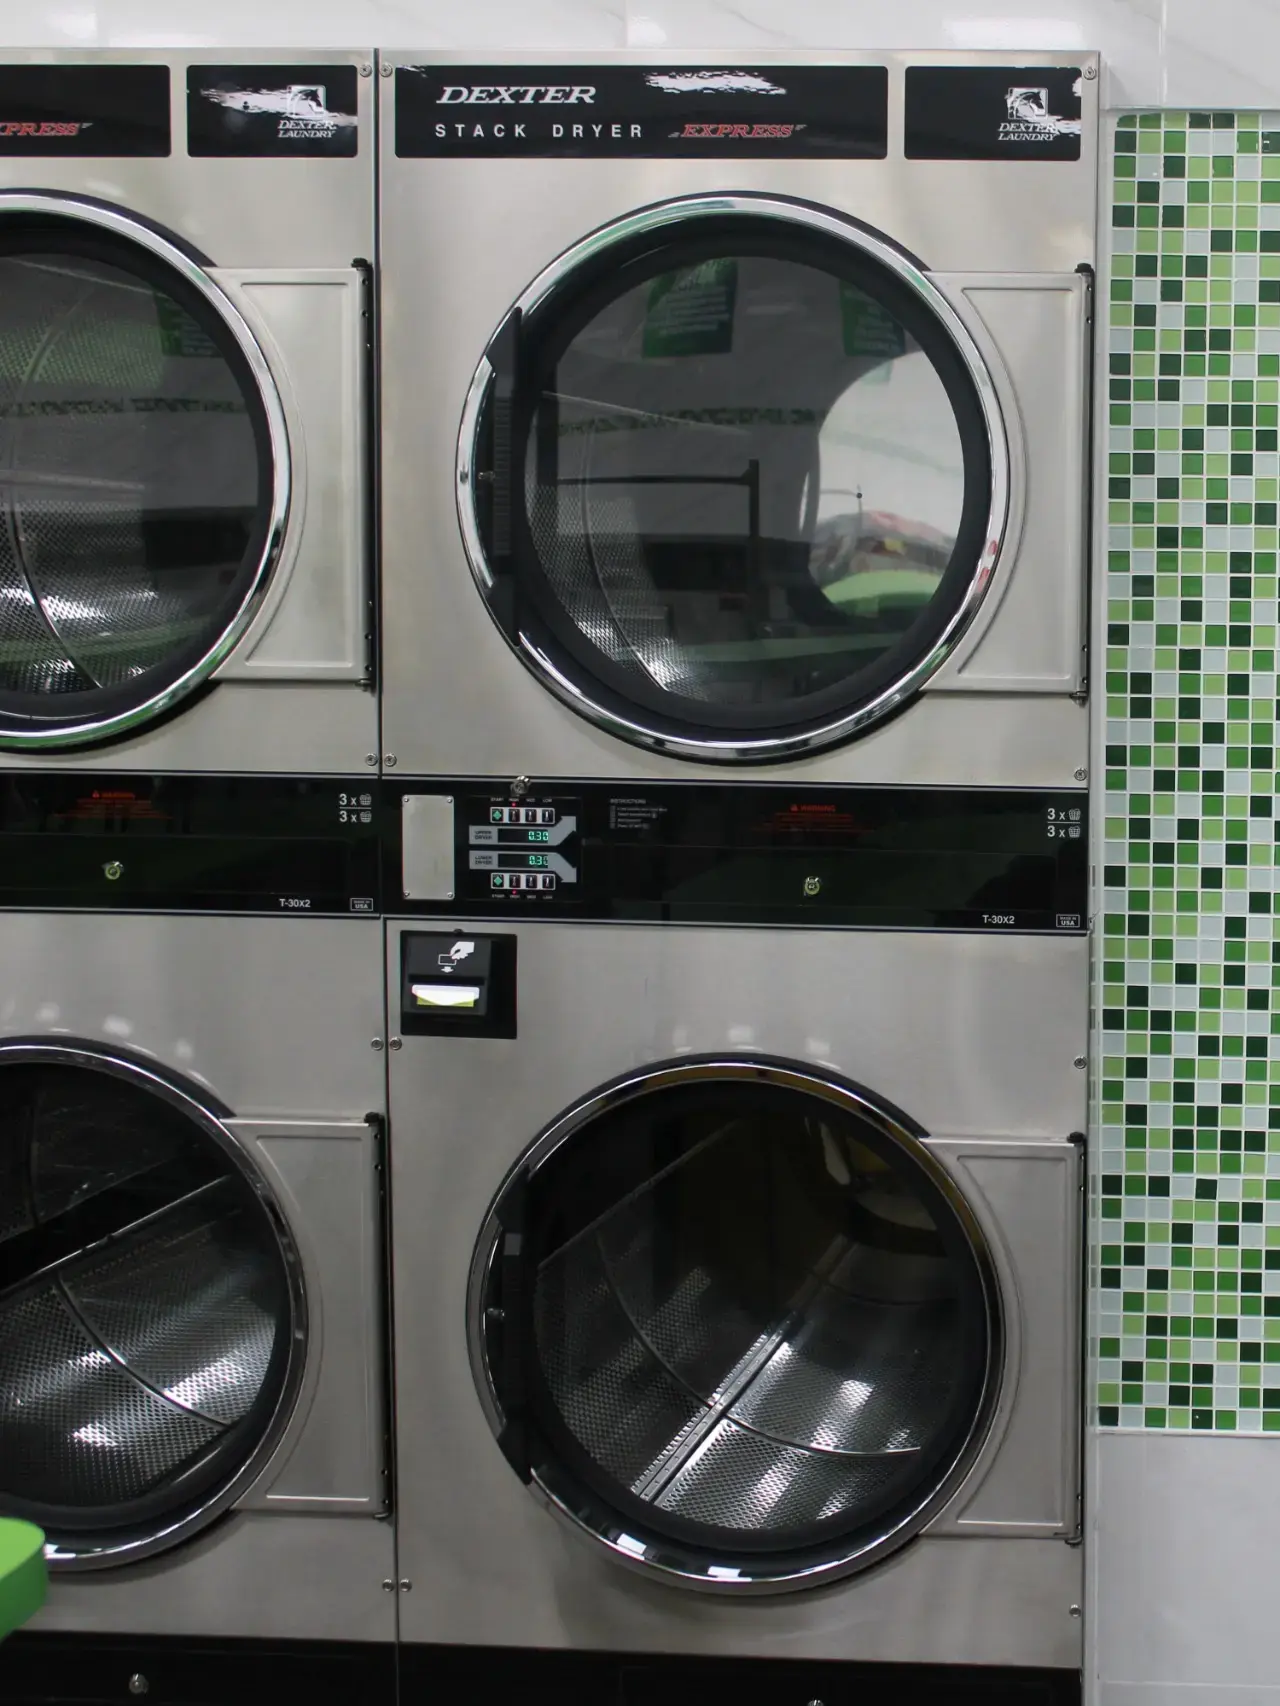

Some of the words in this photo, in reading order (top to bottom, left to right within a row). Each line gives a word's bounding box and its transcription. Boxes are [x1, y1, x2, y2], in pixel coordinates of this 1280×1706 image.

[436, 86, 596, 104] DEXTER
[0, 122, 80, 136] PRESS
[278, 120, 336, 130] DEXTER
[436, 124, 527, 137] STACK
[553, 125, 642, 138] DRYER
[680, 124, 794, 138] EXPRESS
[998, 123, 1058, 133] DEXTER
[278, 130, 336, 138] LAUNDRY
[998, 133, 1057, 141] LAUNDRY
[340, 793, 347, 806] 3
[351, 797, 357, 805] x
[340, 810, 347, 822] 3
[351, 814, 357, 822] x
[1048, 807, 1056, 820] 3
[1060, 811, 1066, 820] x
[1048, 825, 1056, 837] 3
[1060, 829, 1066, 838] x
